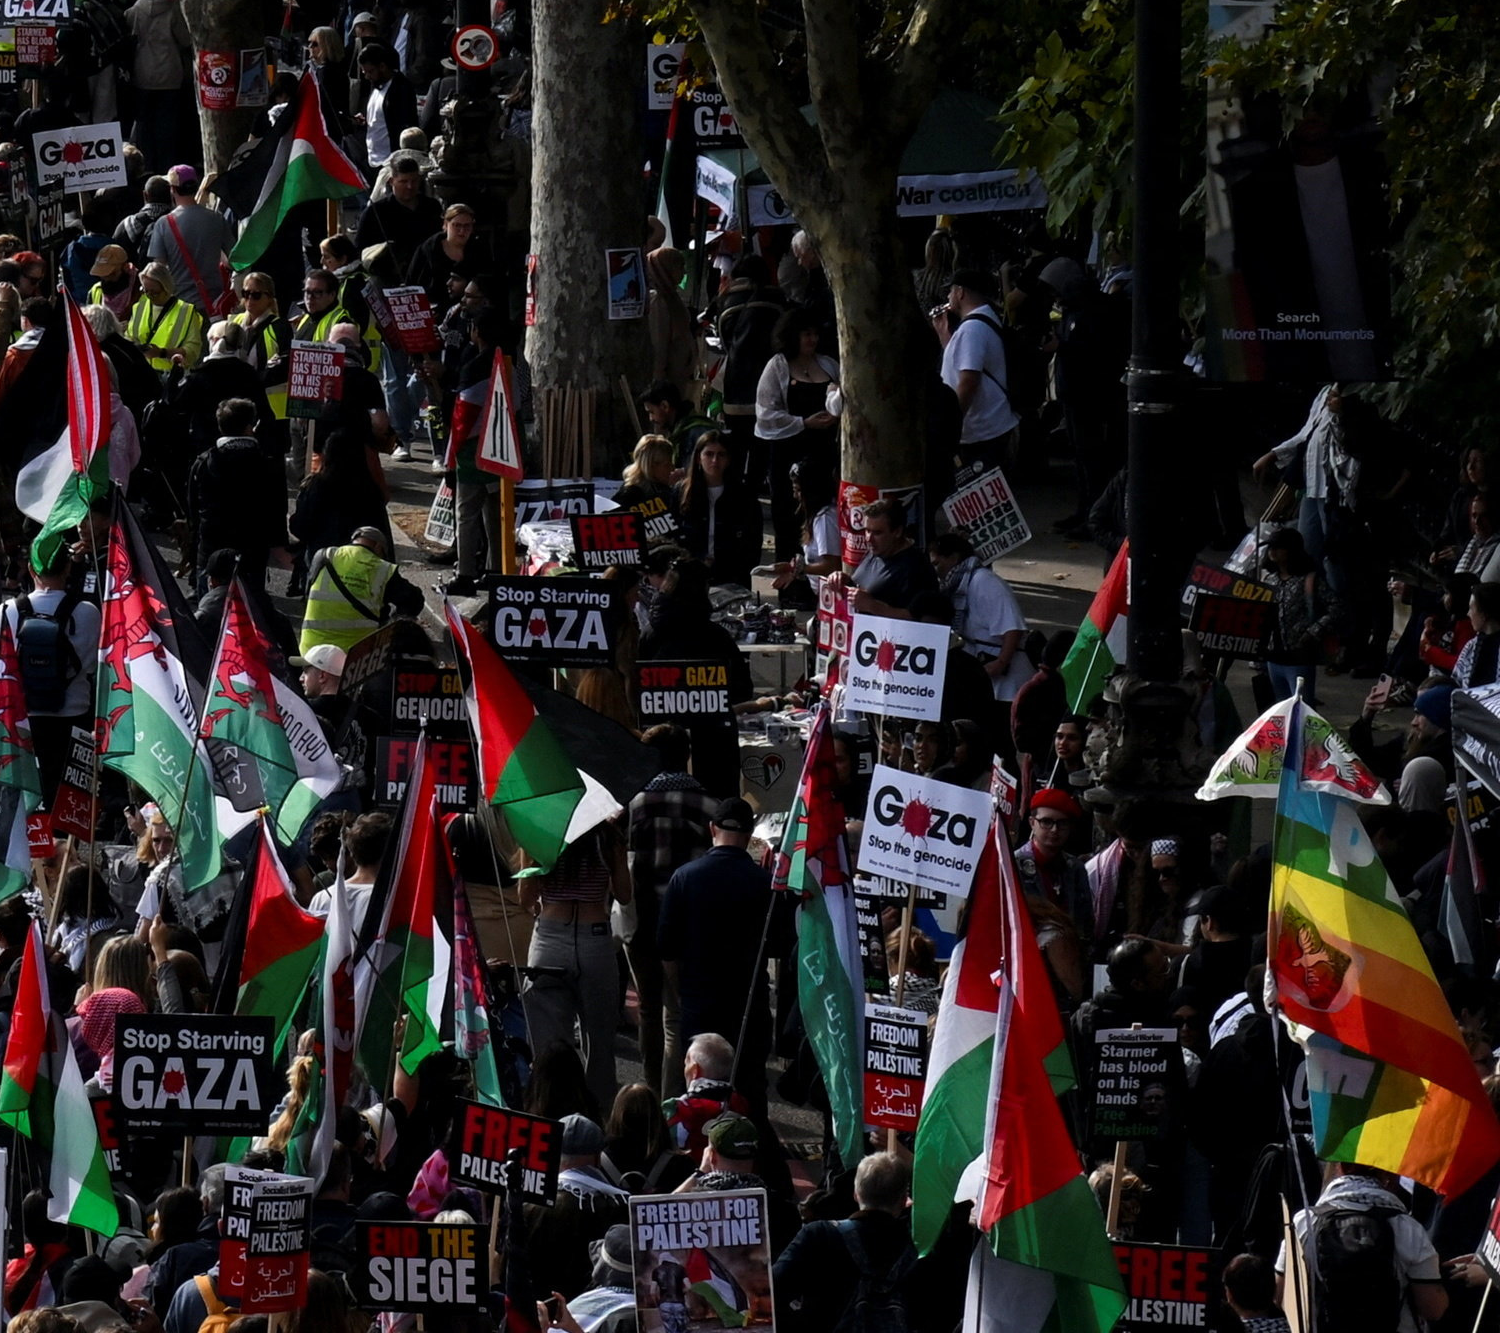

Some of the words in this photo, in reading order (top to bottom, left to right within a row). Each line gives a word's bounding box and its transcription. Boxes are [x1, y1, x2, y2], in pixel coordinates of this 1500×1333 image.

[1277, 313, 1320, 323] Search
[1222, 329, 1255, 341] More
[1258, 329, 1290, 341] Than
[1295, 329, 1375, 341] Monuments
[496, 585, 535, 605] Stop
[539, 587, 611, 608] Starving
[495, 608, 608, 651] GAZA
[122, 1028, 173, 1052] Stop
[177, 1029, 266, 1056] Starving
[1100, 1044, 1158, 1059] Starmer
[1099, 1060, 1123, 1074] has
[1128, 1059, 1167, 1073] blood
[120, 1056, 261, 1111] GAZA
[1098, 1079, 1114, 1091] on
[1117, 1076, 1140, 1090] his
[1096, 1092, 1138, 1106] hands
[637, 1201, 720, 1226] FREEDOM
[724, 1198, 759, 1219] FOR
[368, 1226, 420, 1257] END
[427, 1228, 476, 1259] THE
[638, 1219, 762, 1252] PALESTINE
[368, 1258, 477, 1303] SIEGE
